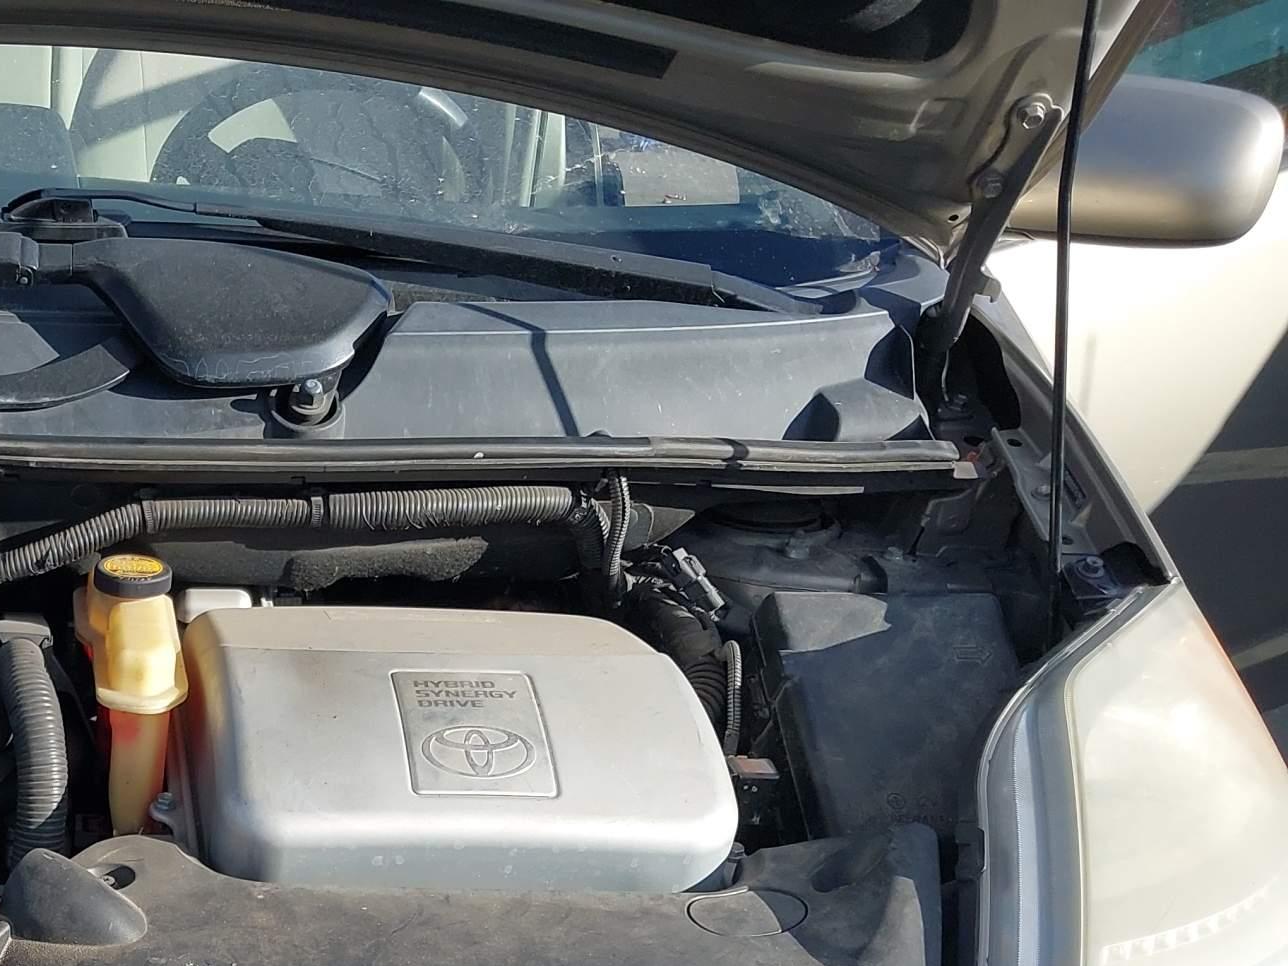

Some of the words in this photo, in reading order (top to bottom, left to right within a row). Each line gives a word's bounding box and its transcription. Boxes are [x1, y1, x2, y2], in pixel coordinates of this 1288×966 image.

[413, 680, 496, 689] HYBRID
[415, 690, 518, 699] SYNERGY
[418, 699, 486, 708] DRIVE
